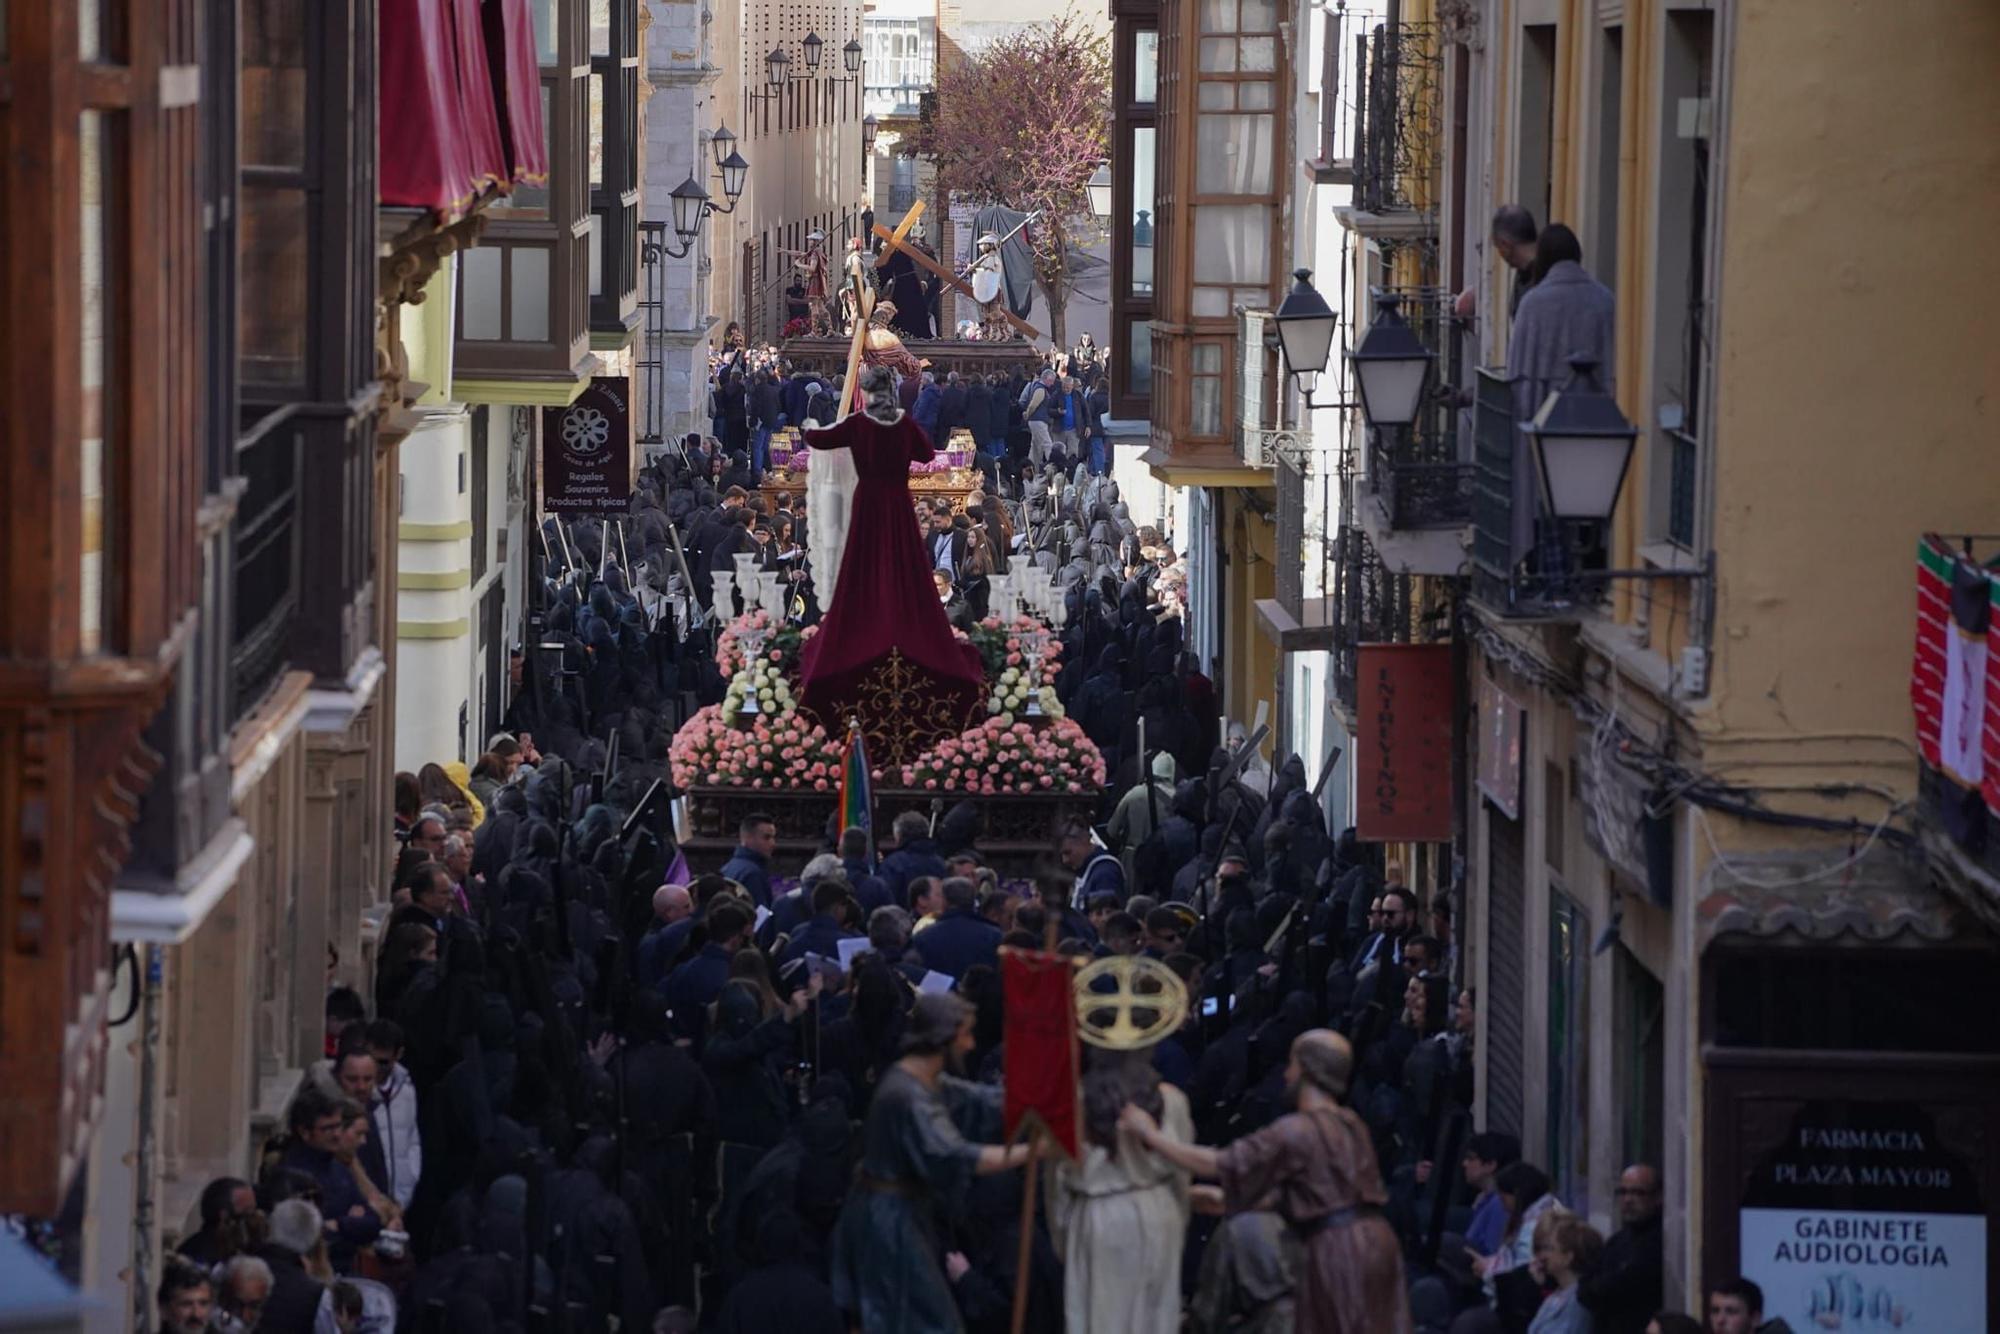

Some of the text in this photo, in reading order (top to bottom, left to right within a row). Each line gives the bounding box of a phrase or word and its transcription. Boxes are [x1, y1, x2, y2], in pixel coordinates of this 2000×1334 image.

[565, 484, 609, 494] Souvenirs
[569, 472, 604, 483] Regalos
[547, 496, 592, 507] Productos
[1800, 1127, 1925, 1152] FARMACIA
[1775, 1163, 1952, 1189] PLAZA MAYOR
[1795, 1217, 1928, 1242] GABINETE
[1774, 1241, 1949, 1268] AUDIOLOGIA
